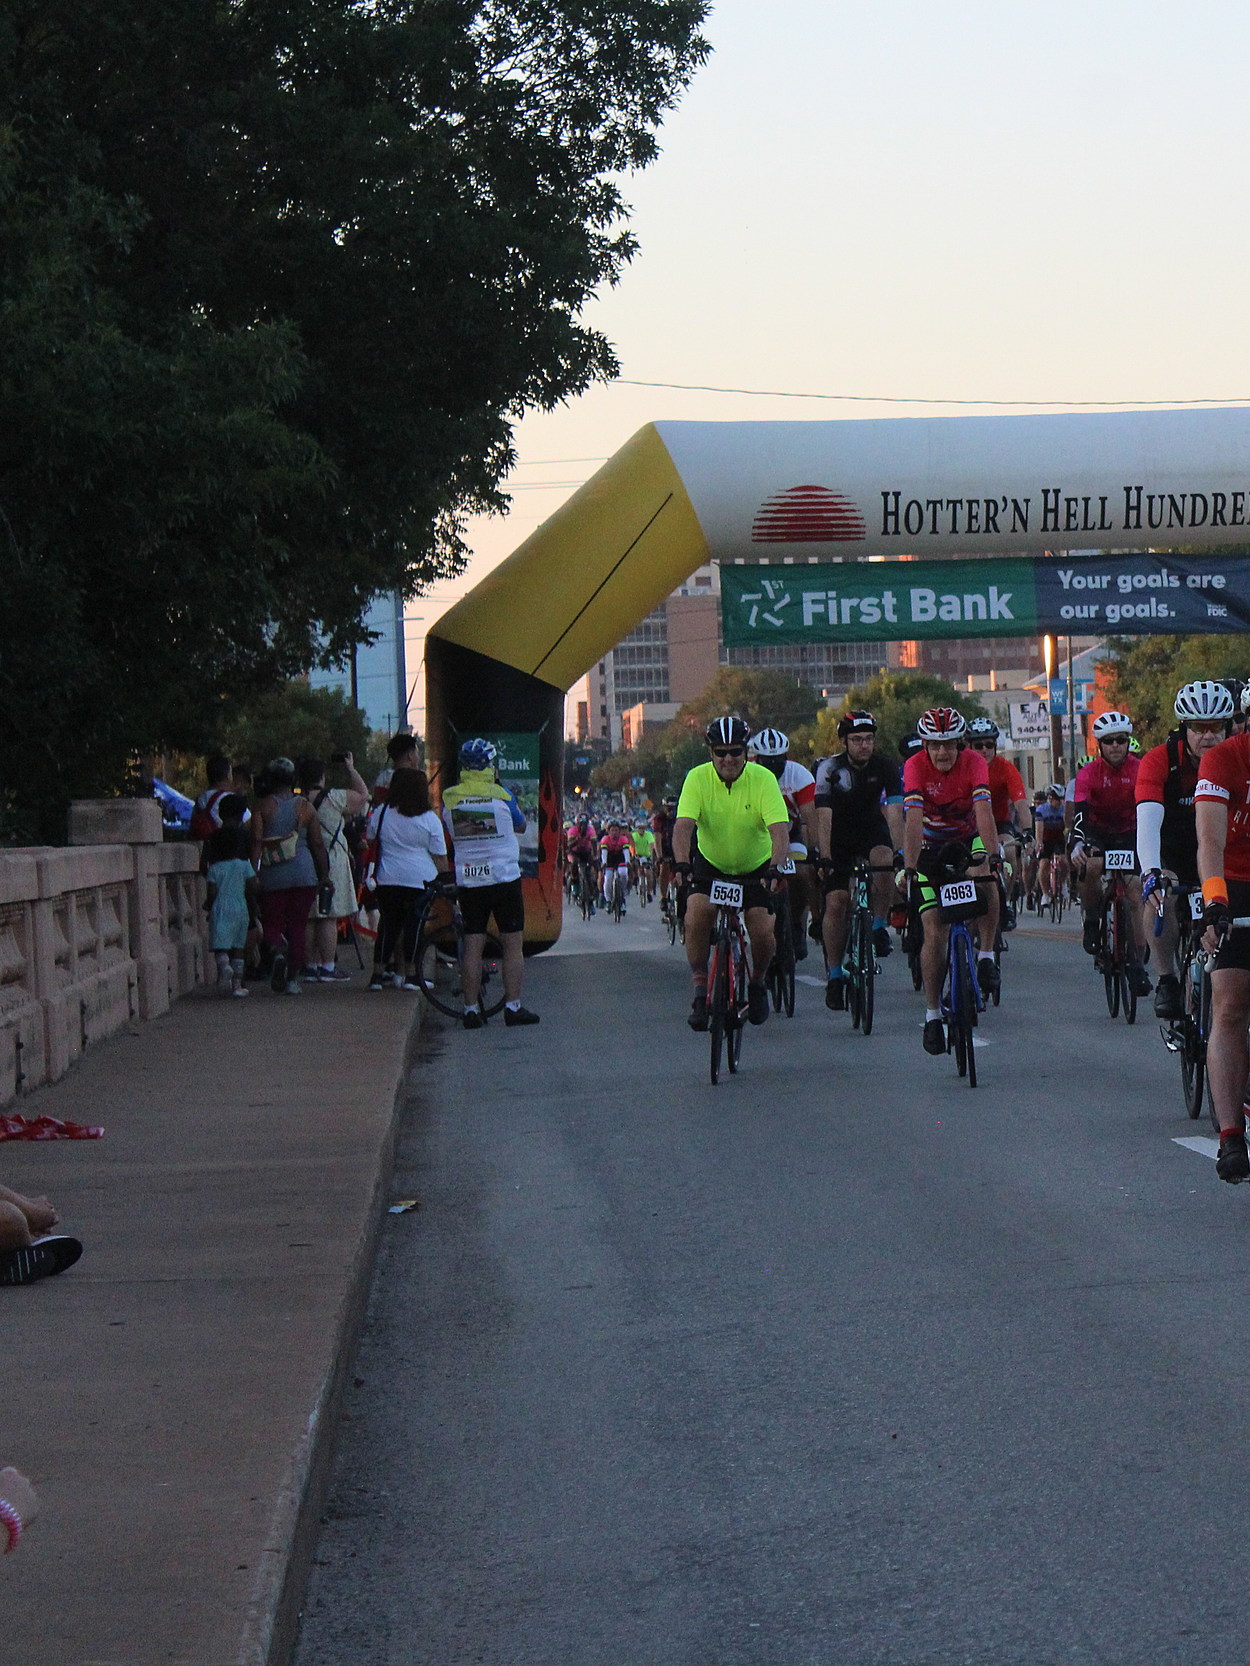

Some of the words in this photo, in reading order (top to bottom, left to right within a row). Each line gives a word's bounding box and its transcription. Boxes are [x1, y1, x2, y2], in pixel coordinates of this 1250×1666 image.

[881, 491, 1031, 536] HOTTER'N
[1040, 488, 1113, 533] HELL
[1057, 569, 1112, 590] Your
[1117, 567, 1181, 593] goals
[1186, 573, 1226, 590] are
[802, 590, 898, 626] First
[910, 586, 1015, 623] Bank
[1059, 603, 1099, 619] our
[1105, 597, 1176, 624] goals.
[1207, 608, 1228, 617] FDIC
[498, 758, 530, 771] Bank
[1108, 853, 1132, 866] 2374
[464, 865, 490, 877] 9026
[713, 885, 740, 902] 5543
[944, 884, 973, 902] 4963
